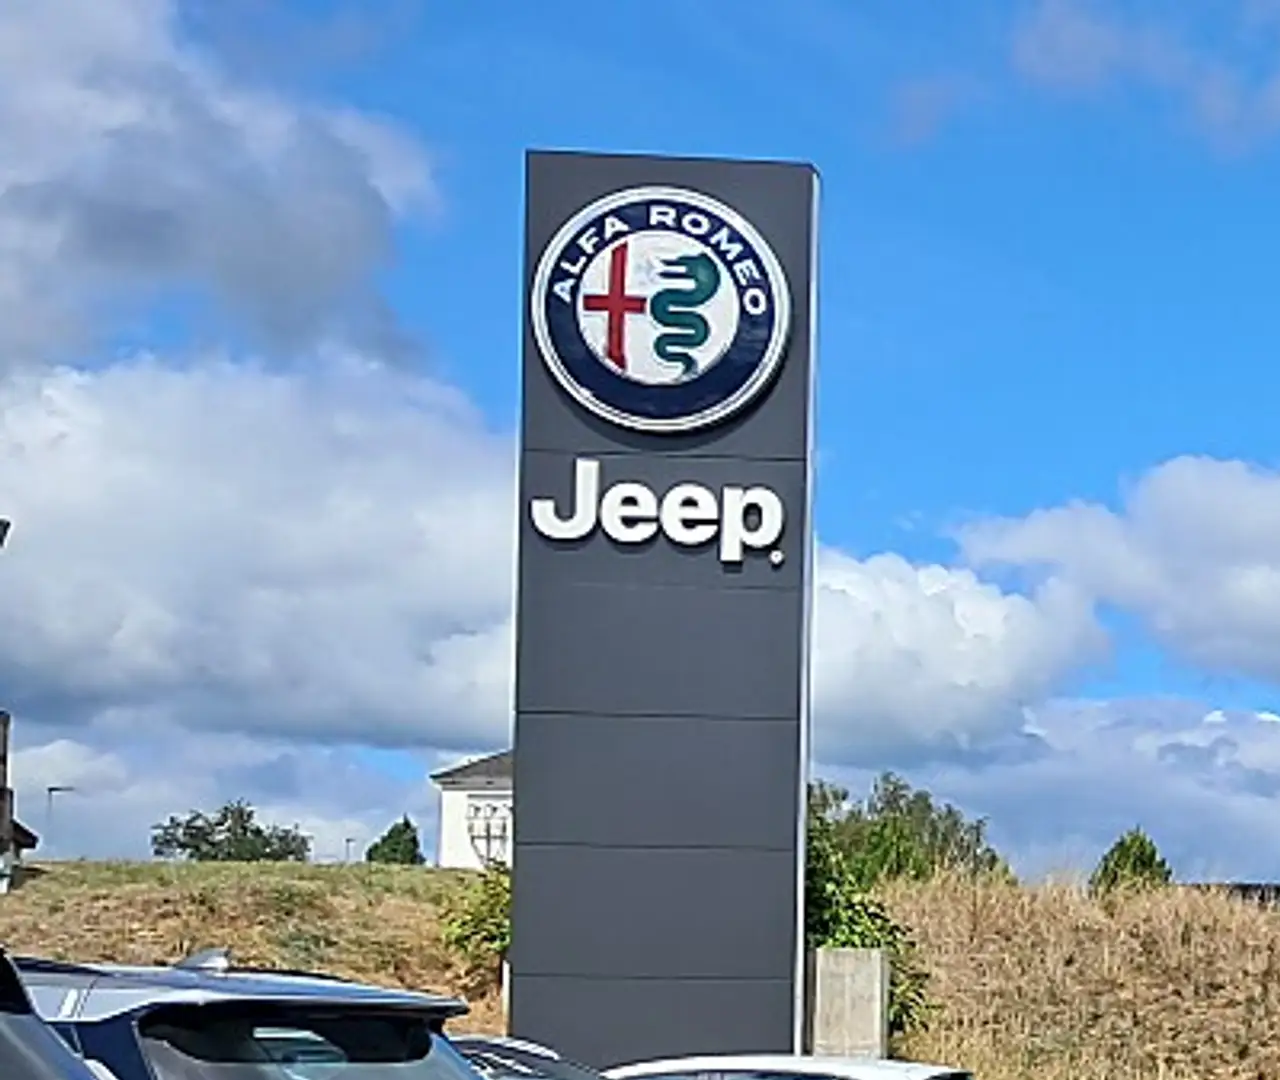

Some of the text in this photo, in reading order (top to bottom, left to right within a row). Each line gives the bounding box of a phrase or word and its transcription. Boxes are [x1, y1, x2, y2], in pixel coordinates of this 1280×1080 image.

[552, 205, 767, 316] ALFA ROMEO
[531, 457, 784, 563] Jeep
